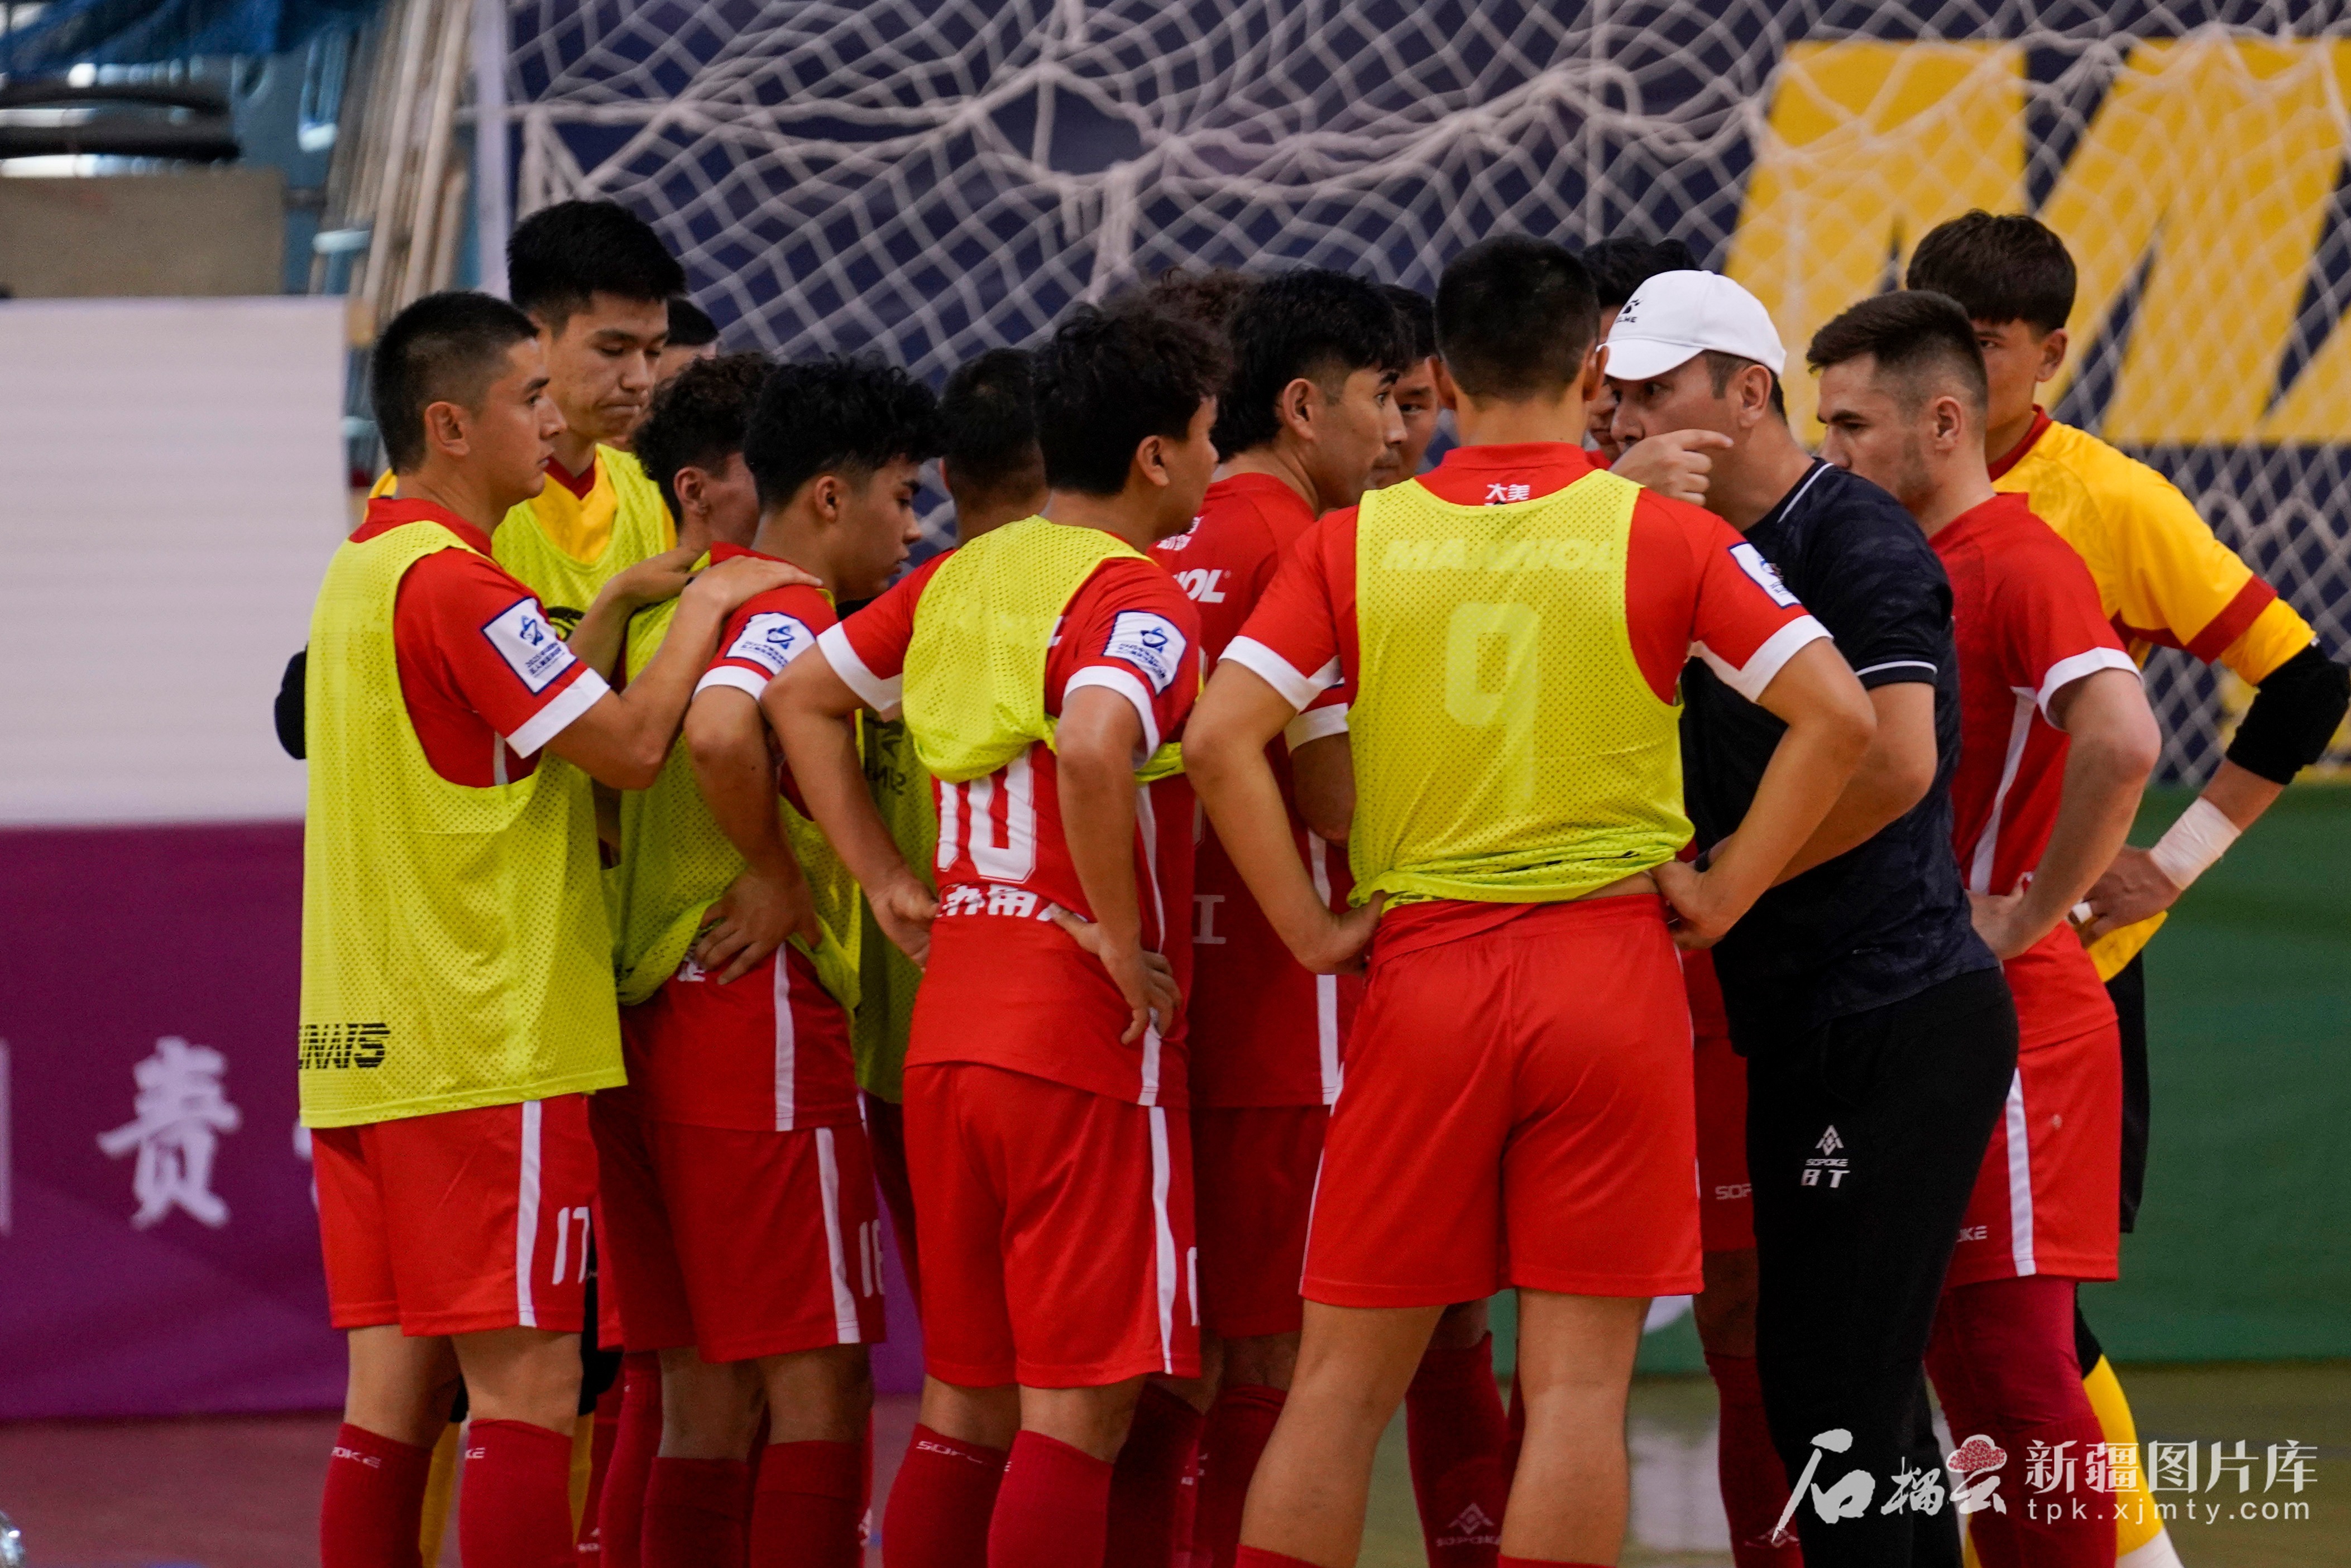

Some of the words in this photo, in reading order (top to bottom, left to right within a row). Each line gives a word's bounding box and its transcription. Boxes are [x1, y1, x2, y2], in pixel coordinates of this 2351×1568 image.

[1484, 483, 1530, 501] 大美
[1715, 1183, 1752, 1201] SOP
[552, 1206, 590, 1285] 17
